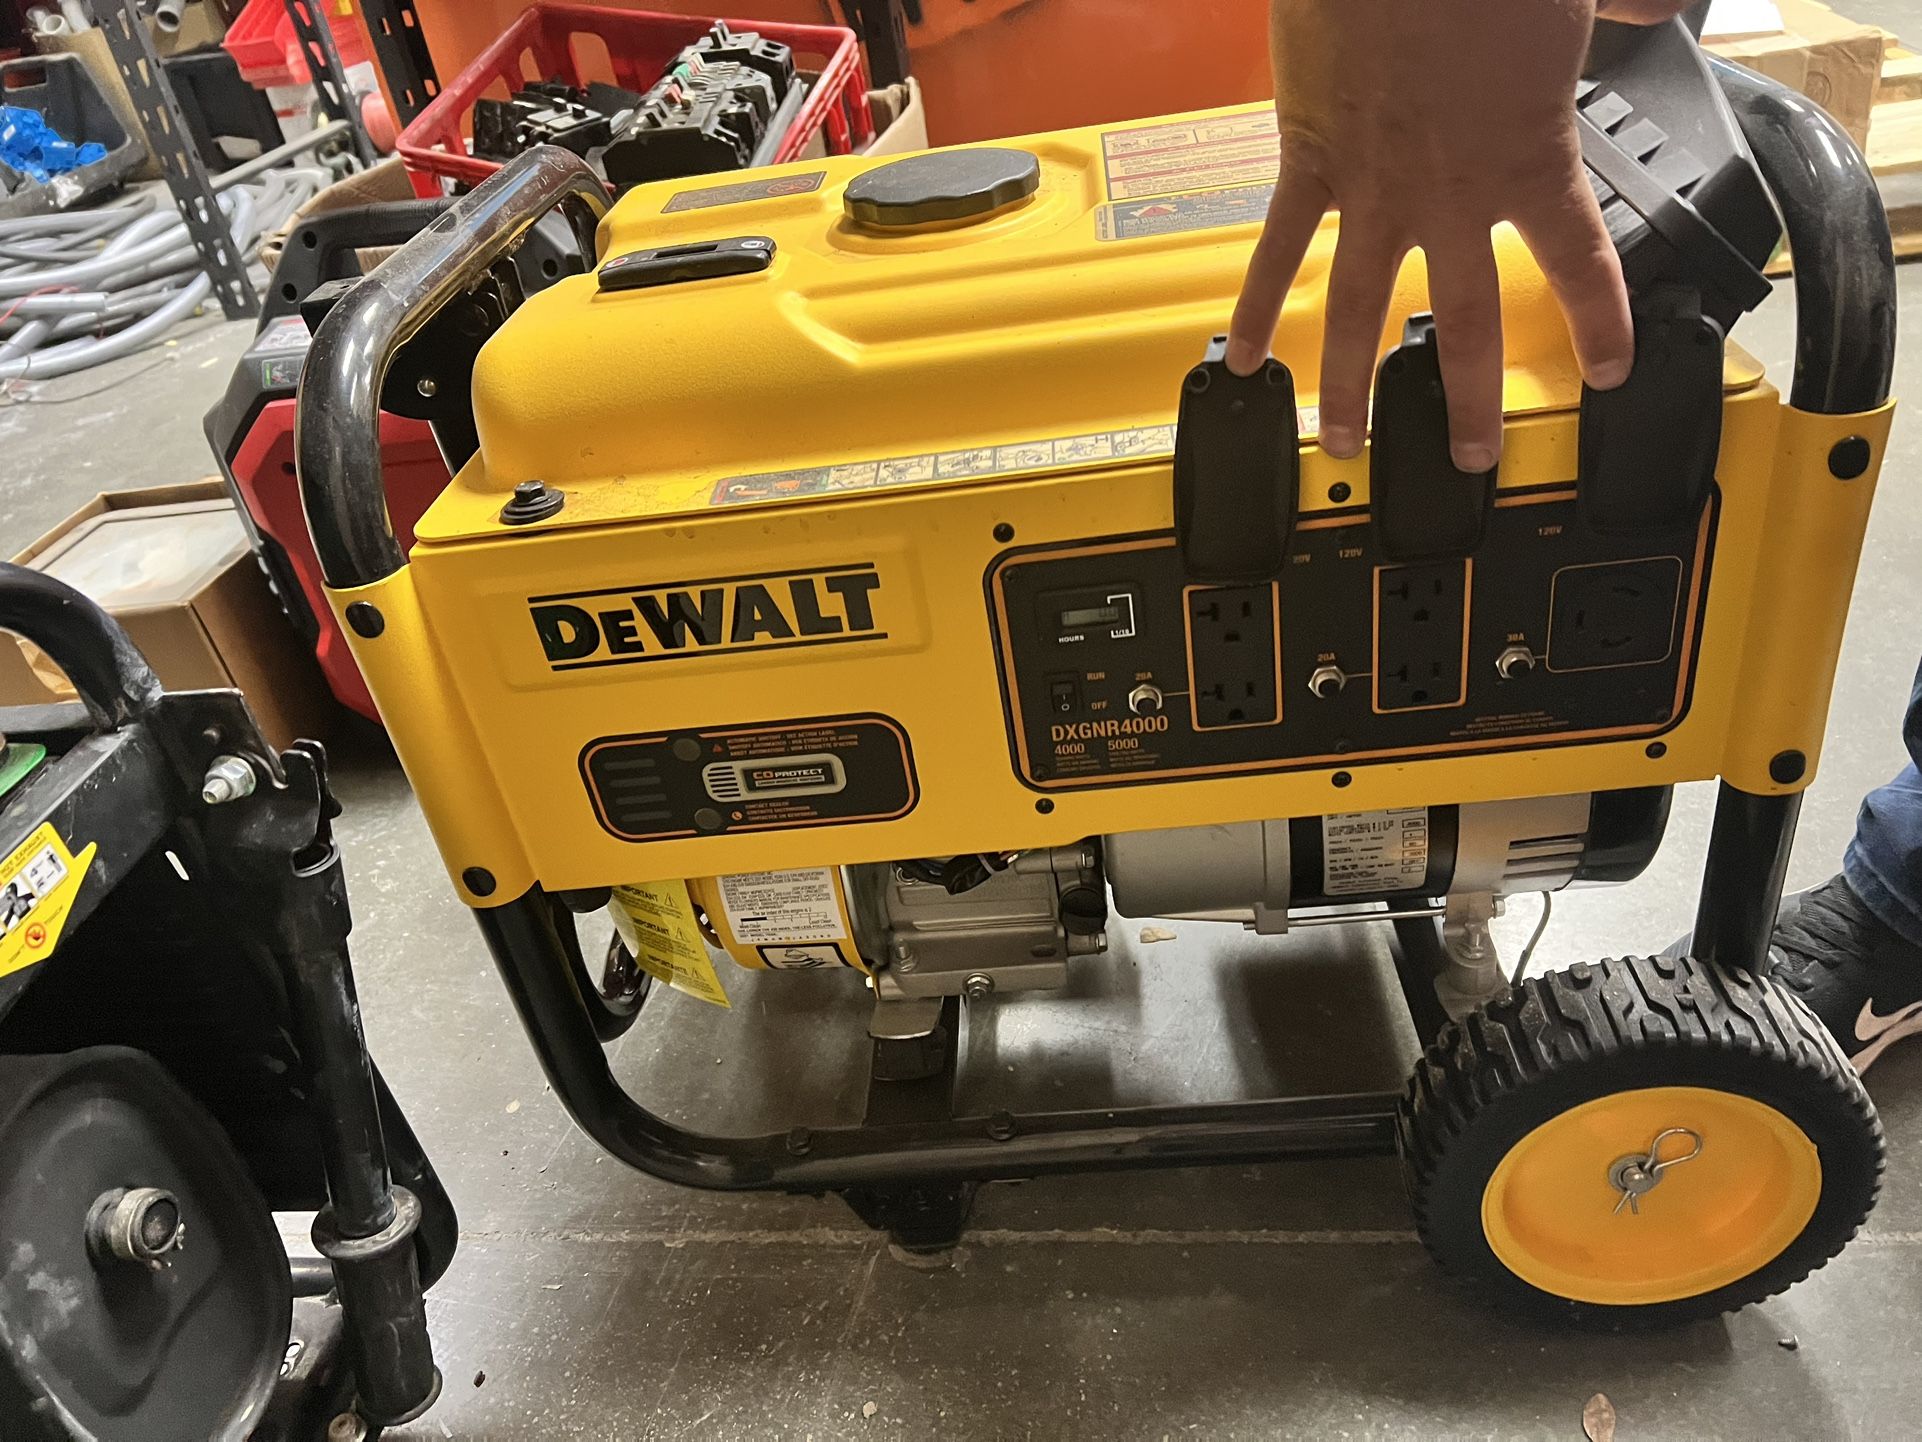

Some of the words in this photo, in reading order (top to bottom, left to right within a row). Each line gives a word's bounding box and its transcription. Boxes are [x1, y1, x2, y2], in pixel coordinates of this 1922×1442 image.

[1339, 547, 1364, 559] 120V
[529, 571, 882, 663] DEWALT
[1058, 634, 1086, 644] HOURS
[1087, 671, 1106, 681] RUN
[1091, 700, 1109, 711] OFF
[1051, 715, 1169, 742] DXGNR4000
[1054, 742, 1085, 756] 4000
[1108, 737, 1139, 751] 5000
[752, 771, 775, 780] CO
[775, 768, 824, 778] PROTECT
